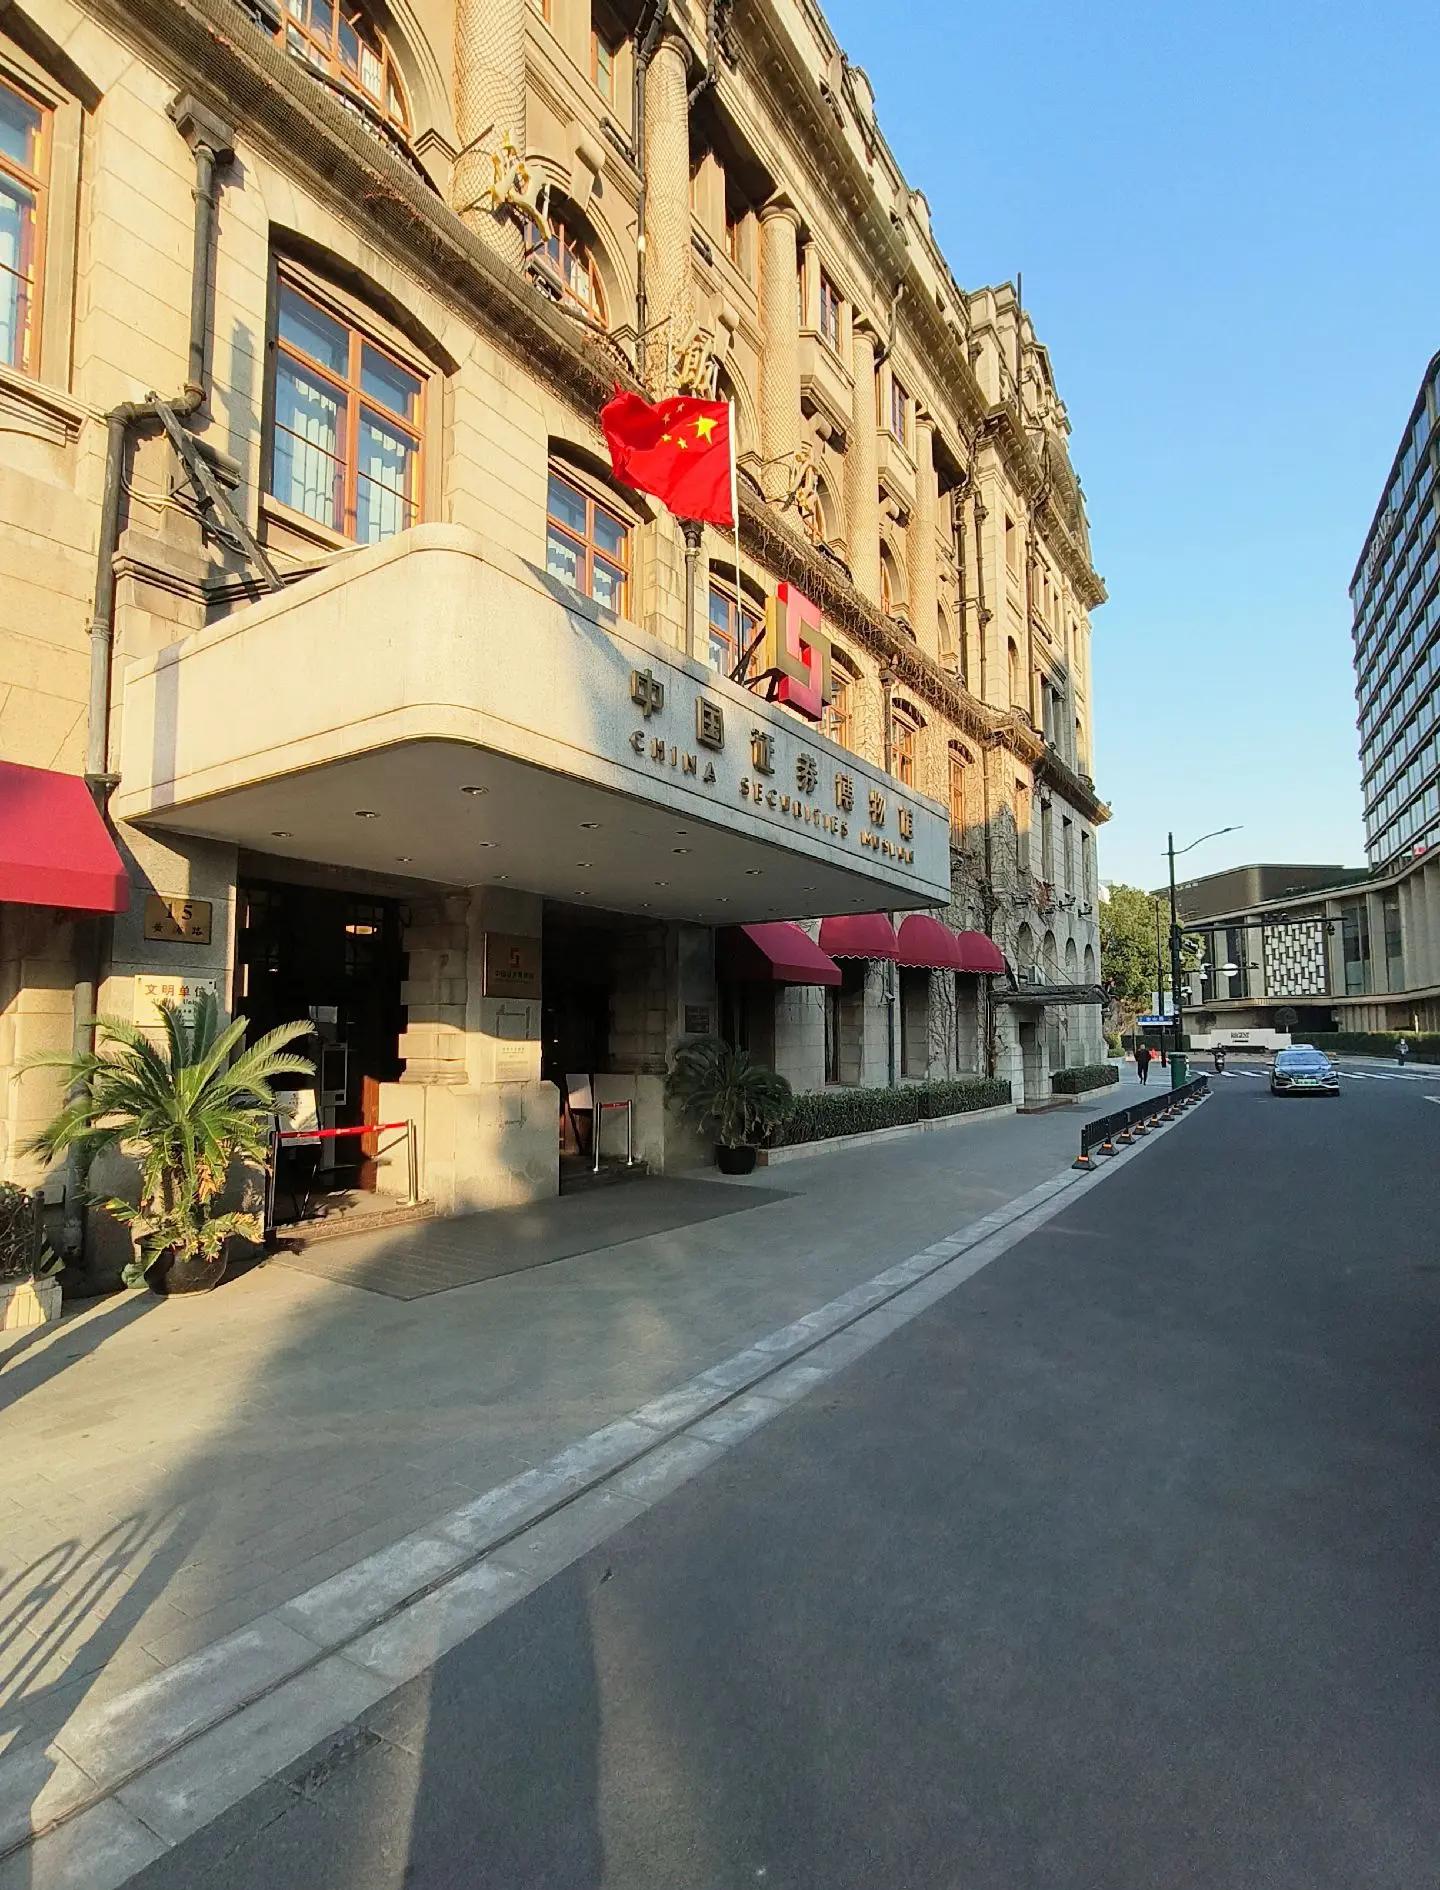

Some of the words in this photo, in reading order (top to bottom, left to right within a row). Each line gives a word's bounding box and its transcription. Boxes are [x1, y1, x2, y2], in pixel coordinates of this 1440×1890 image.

[629, 730, 717, 783] CHINA
[740, 777, 849, 838] SECURITIES
[860, 831, 914, 864] MUSEUM
